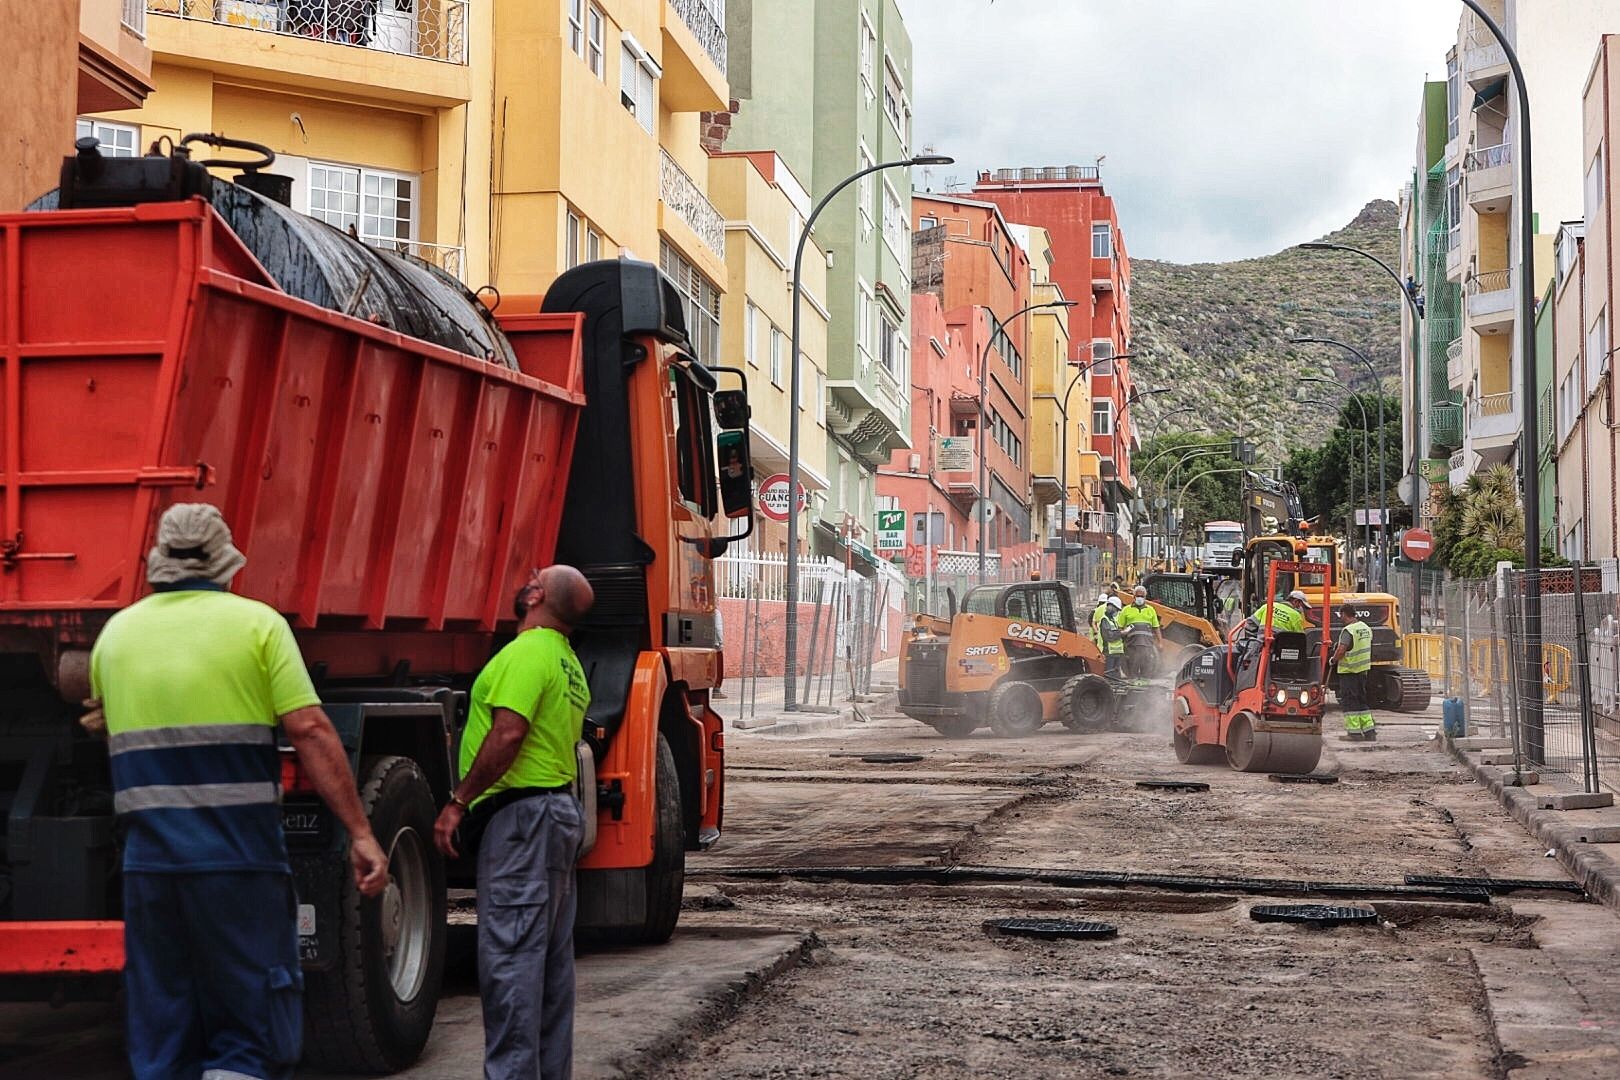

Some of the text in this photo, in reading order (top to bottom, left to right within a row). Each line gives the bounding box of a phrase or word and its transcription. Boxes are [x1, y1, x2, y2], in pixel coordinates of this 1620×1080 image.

[759, 493, 804, 502] GUANCE
[879, 540, 903, 548] TERRAZA
[1007, 622, 1060, 645] CASE
[965, 645, 999, 656] SR175
